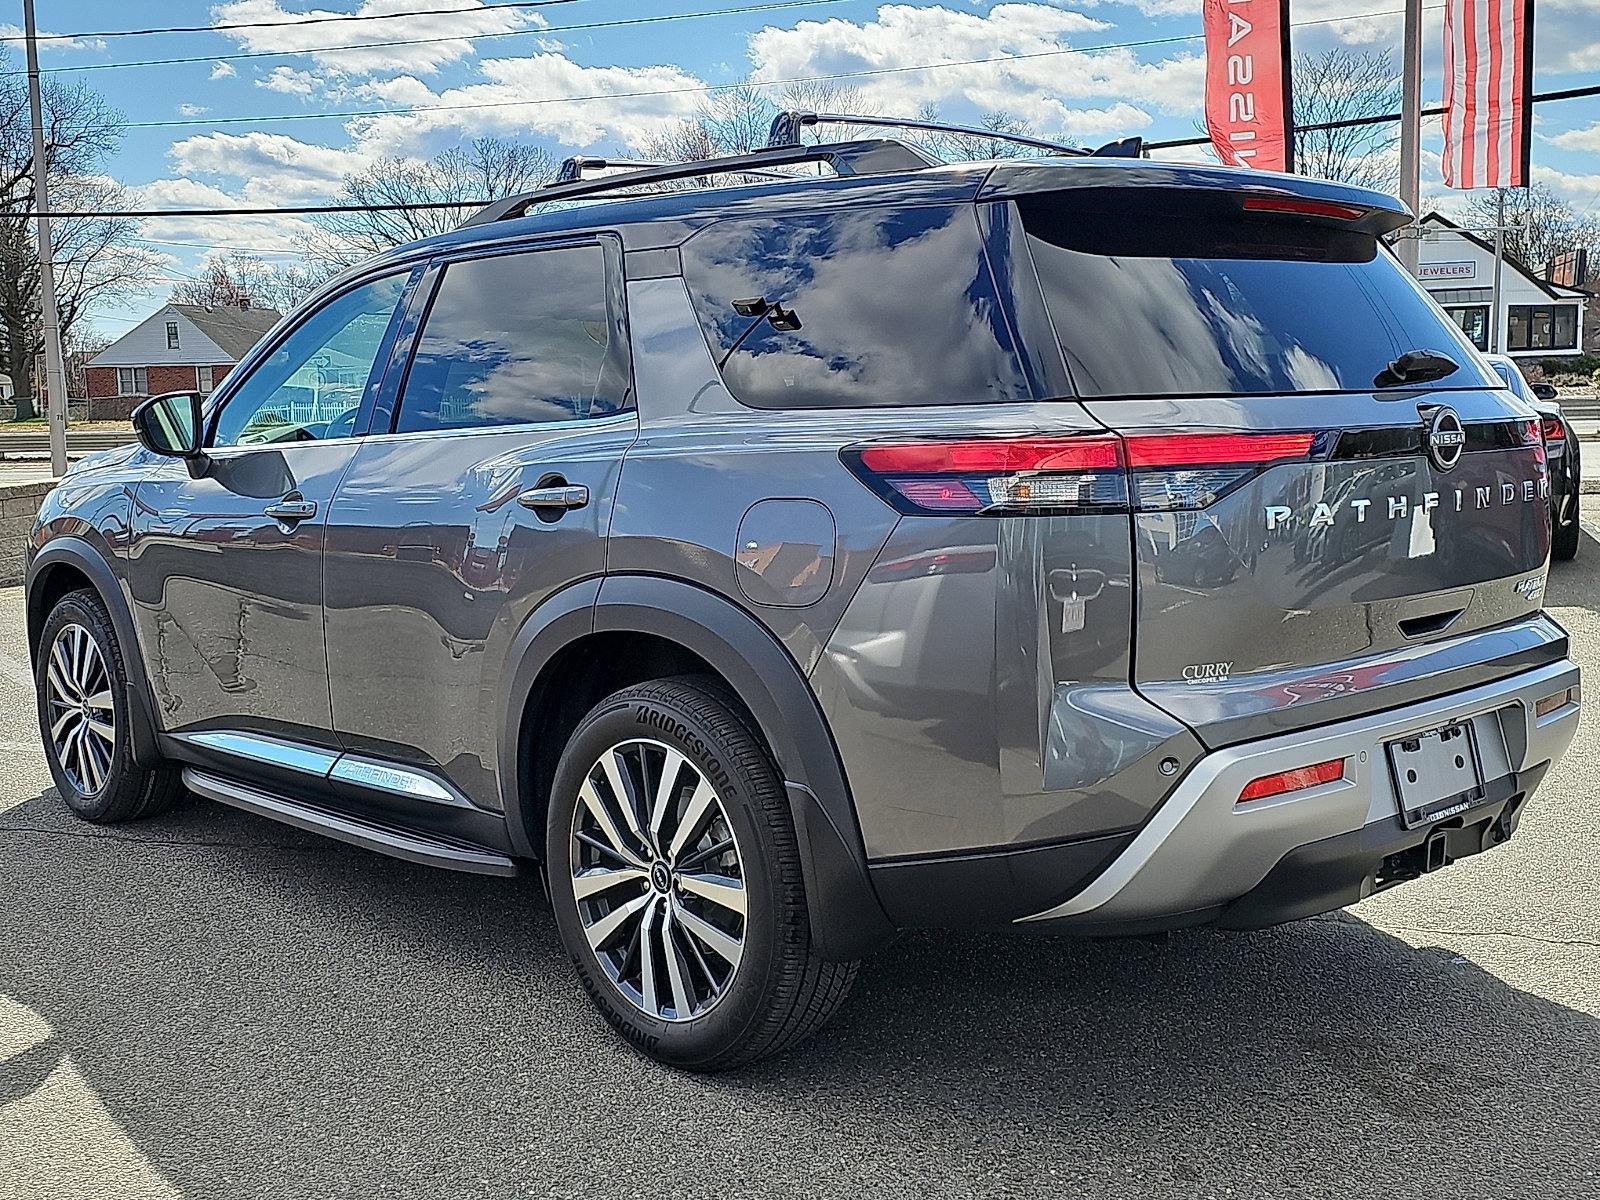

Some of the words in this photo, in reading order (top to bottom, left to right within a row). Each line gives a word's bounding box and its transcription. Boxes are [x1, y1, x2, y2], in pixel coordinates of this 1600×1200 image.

[1418, 266, 1471, 276] JEWELERS
[1431, 434, 1466, 445] NISSAN
[1264, 478, 1548, 530] PATHFINDER
[1182, 661, 1234, 679] CURRY
[635, 705, 738, 800] BRIDGESTONE
[338, 761, 420, 790] PATHFINDER
